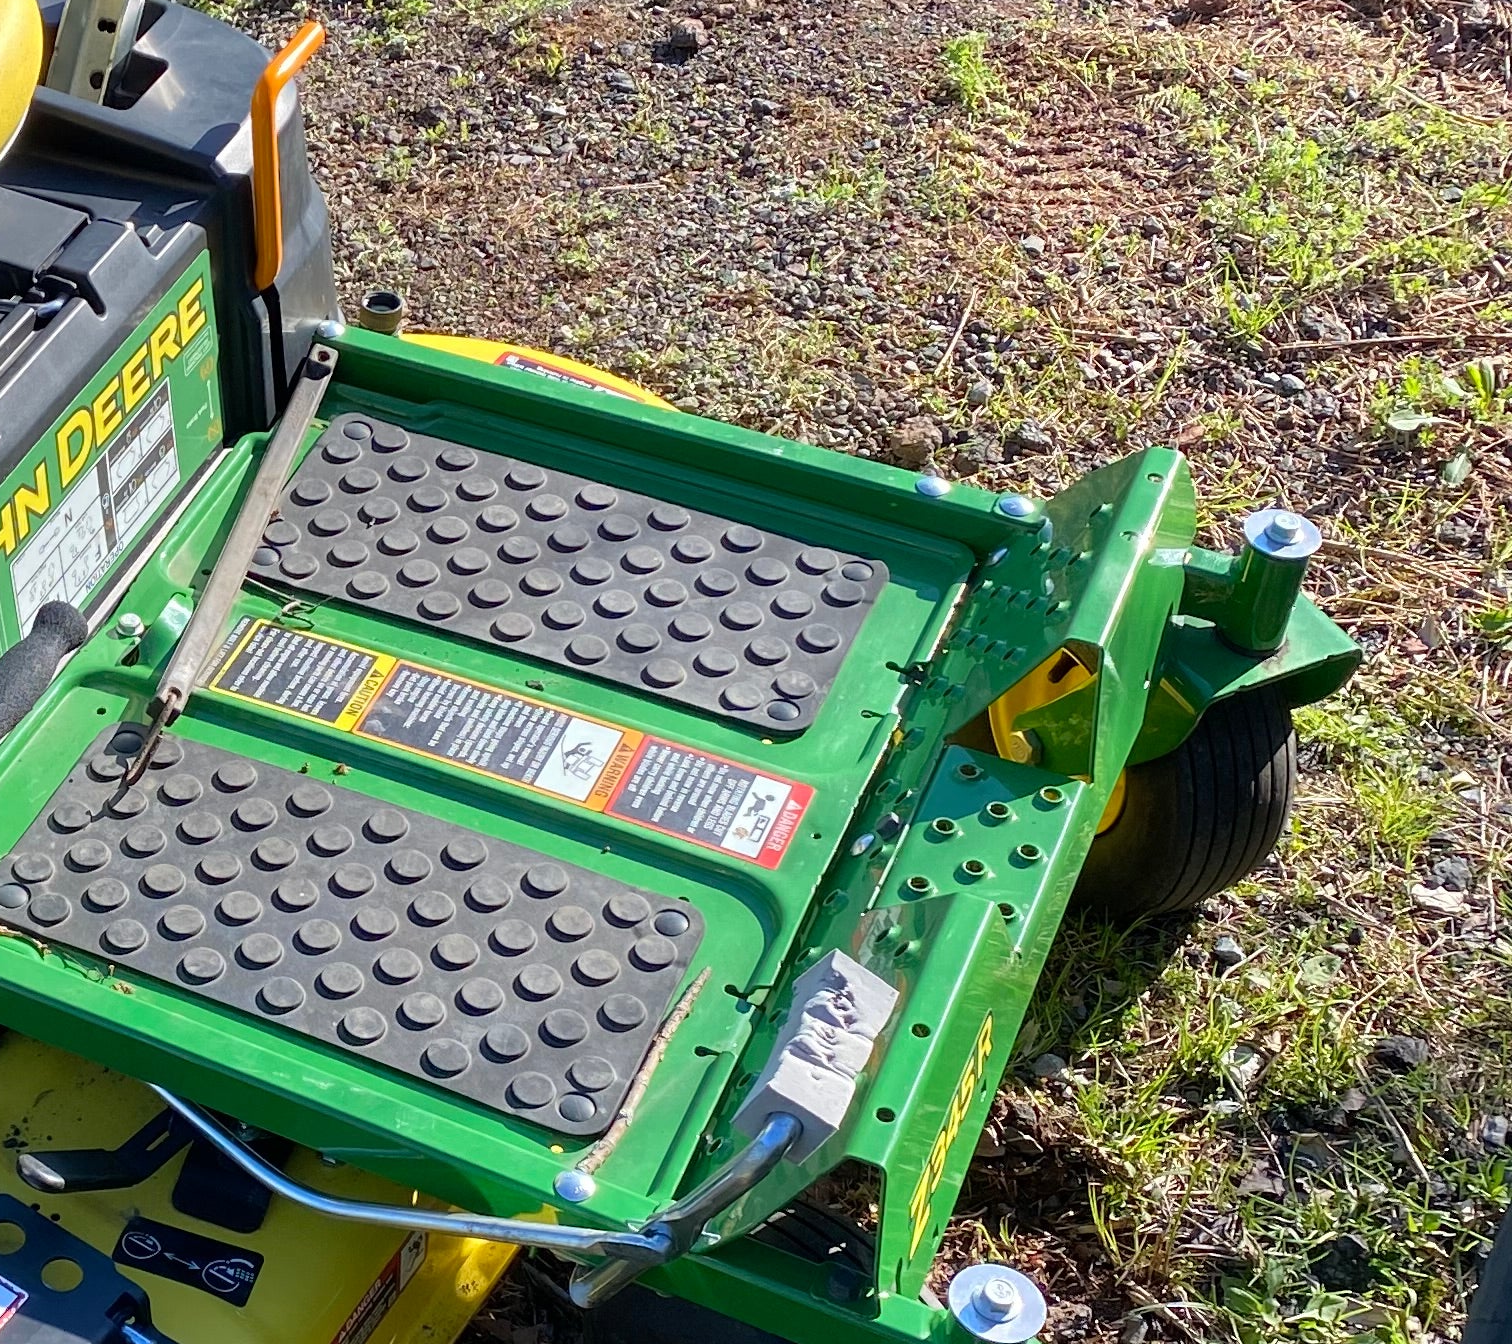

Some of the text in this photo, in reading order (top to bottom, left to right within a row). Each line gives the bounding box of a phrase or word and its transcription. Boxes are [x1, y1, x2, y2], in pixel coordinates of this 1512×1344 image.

[55, 277, 206, 490] DEERE
[85, 538, 126, 592] OPERATION
[345, 678, 378, 717] CAUTION
[593, 752, 630, 799] WARNING
[765, 810, 796, 852] DANGER
[908, 1009, 994, 1262] Z345R
[345, 1278, 381, 1333] DANGER
